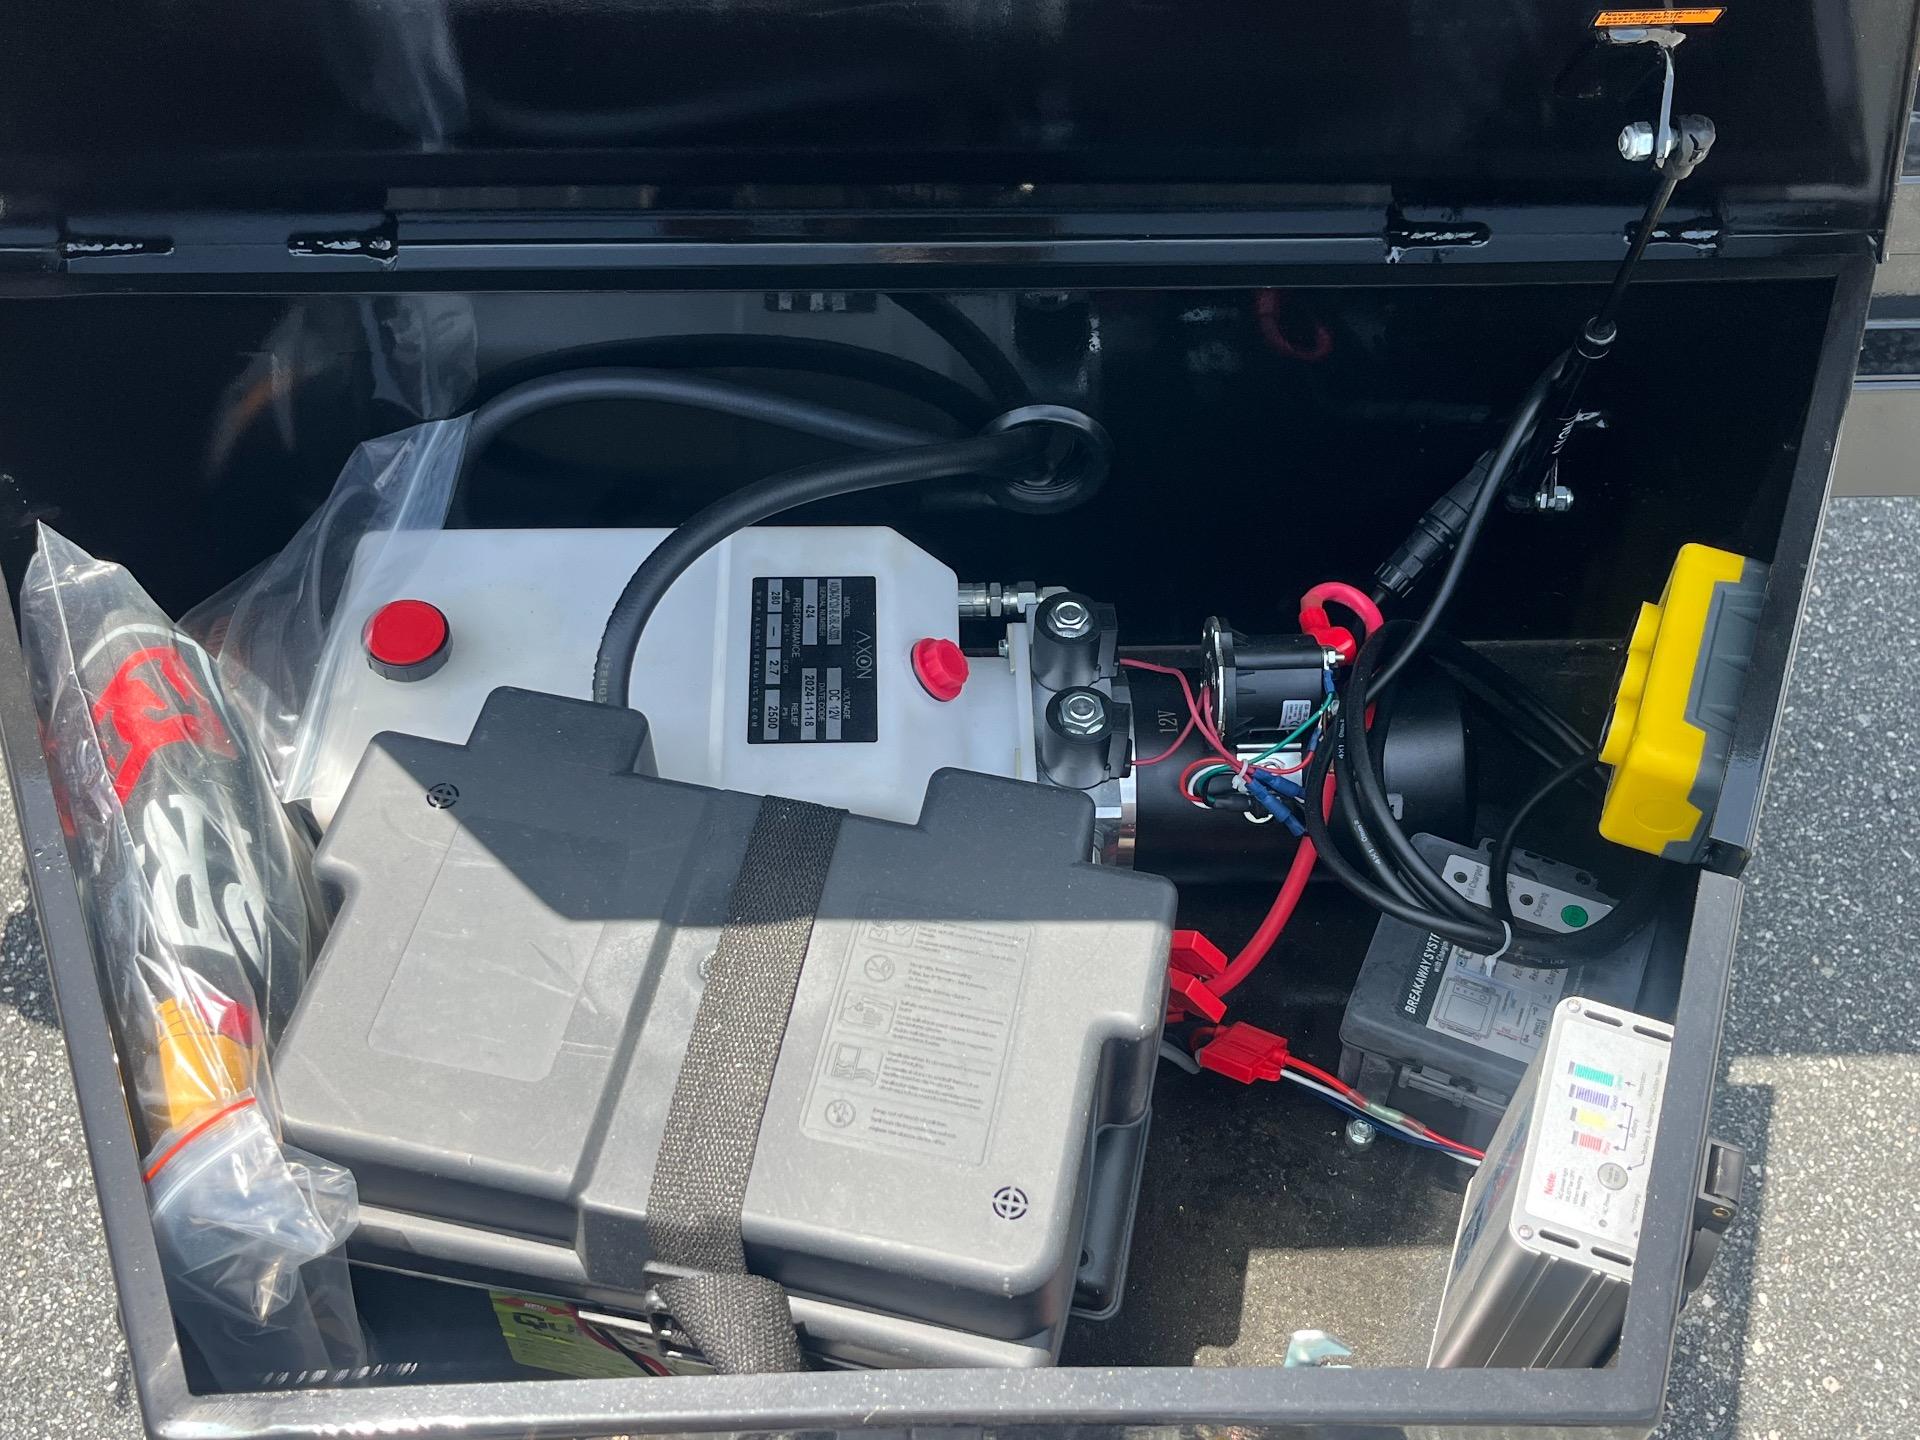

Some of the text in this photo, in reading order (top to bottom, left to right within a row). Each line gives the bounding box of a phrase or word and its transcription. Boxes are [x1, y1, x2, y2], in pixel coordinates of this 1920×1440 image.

[770, 591, 781, 605] 280
[805, 604, 816, 619] 424
[818, 586, 826, 637] SERIAL NUMBER
[843, 596, 851, 618] MODEL
[791, 597, 802, 658] PREFORMANCE
[768, 660, 779, 676] 2.7
[856, 630, 873, 679] AXON
[790, 703, 799, 727] RELIEF
[804, 674, 815, 728] 2024-11-18
[817, 682, 826, 722] DATE CODE
[828, 689, 840, 720] DC 12V
[842, 687, 851, 720] VOLTAGE
[767, 705, 779, 729] 2500
[1157, 708, 1178, 735] 12V
[1404, 957, 1433, 1015] BREAKAWAY
